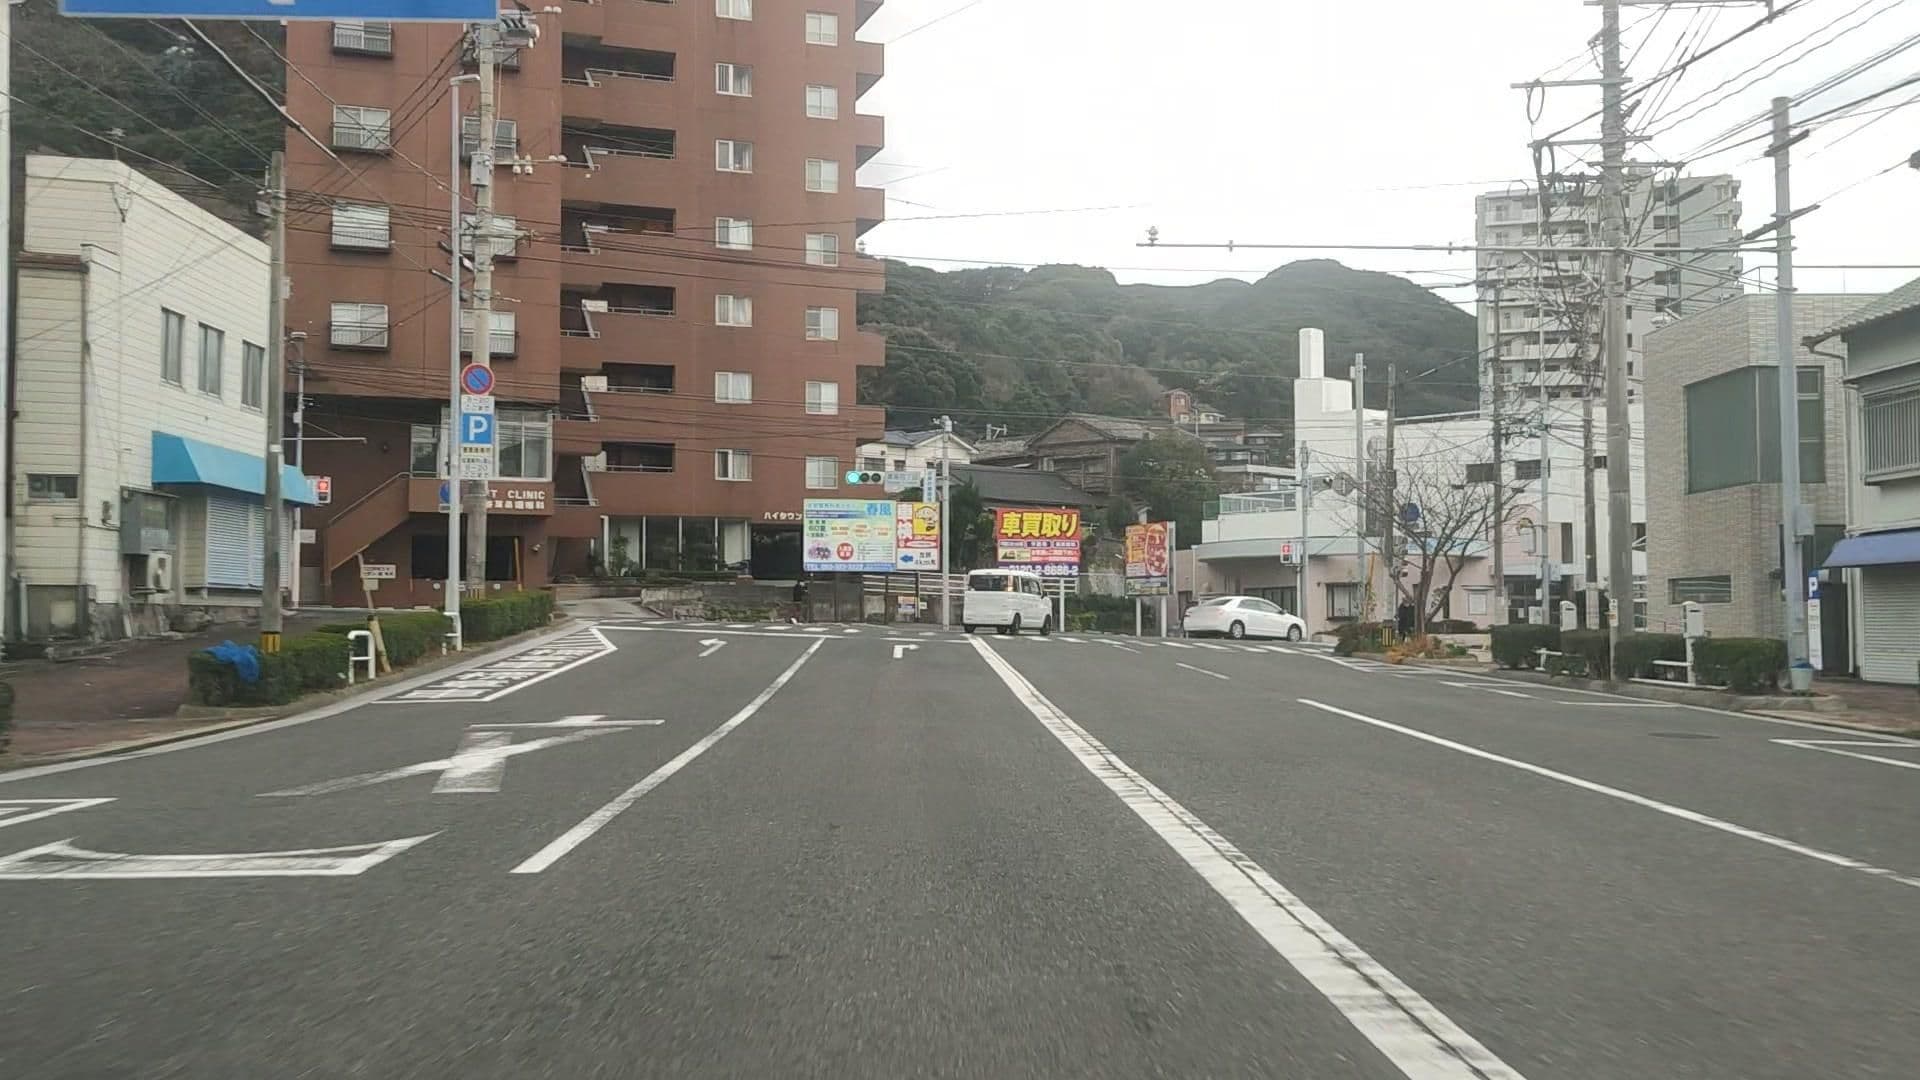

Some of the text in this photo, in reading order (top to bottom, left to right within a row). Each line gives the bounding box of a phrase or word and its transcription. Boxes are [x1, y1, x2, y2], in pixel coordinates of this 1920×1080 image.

[469, 416, 488, 441] P
[507, 490, 546, 500] CLINIC
[763, 511, 803, 521] ハイタウン
[866, 503, 892, 516] 春風
[999, 511, 1078, 538] 車買取り
